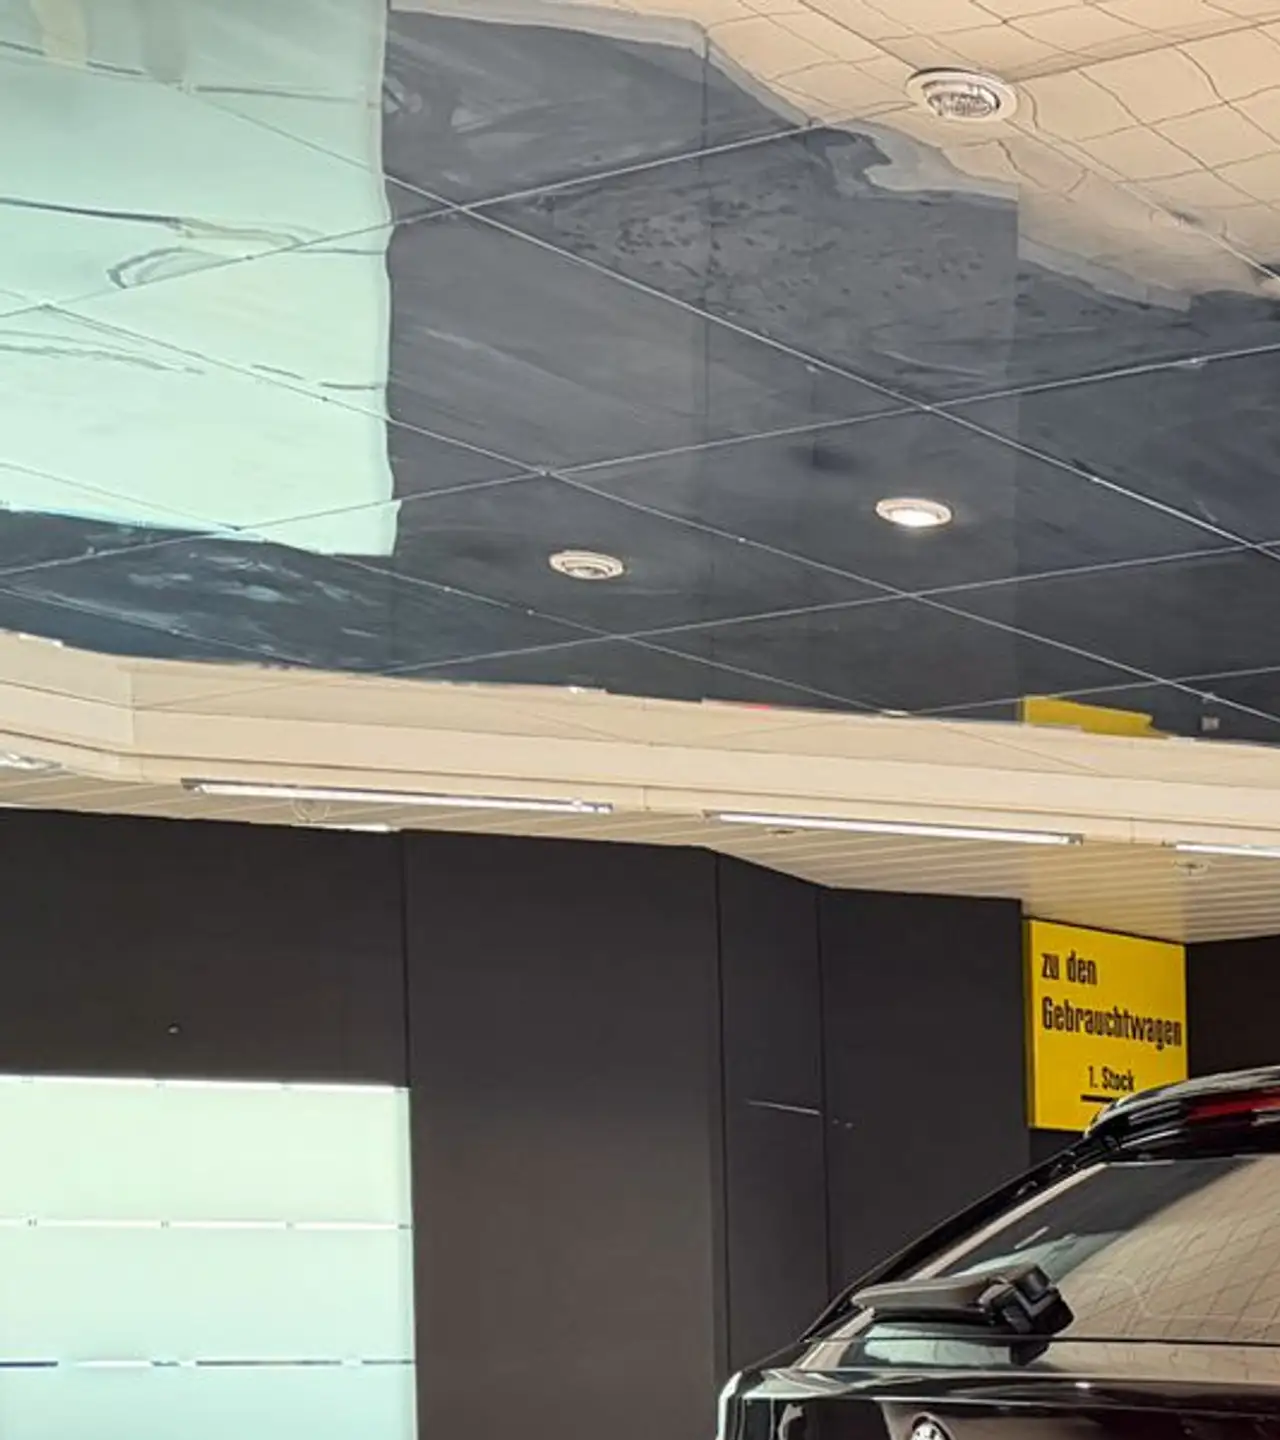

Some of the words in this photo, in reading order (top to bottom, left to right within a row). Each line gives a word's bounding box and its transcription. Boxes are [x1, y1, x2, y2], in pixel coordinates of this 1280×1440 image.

[1041, 952, 1060, 980] zu
[1066, 950, 1097, 985] den
[1042, 996, 1182, 1051] Gebrauchtwagen
[1088, 1065, 1098, 1089] 1.
[1101, 1066, 1134, 1092] Stock
